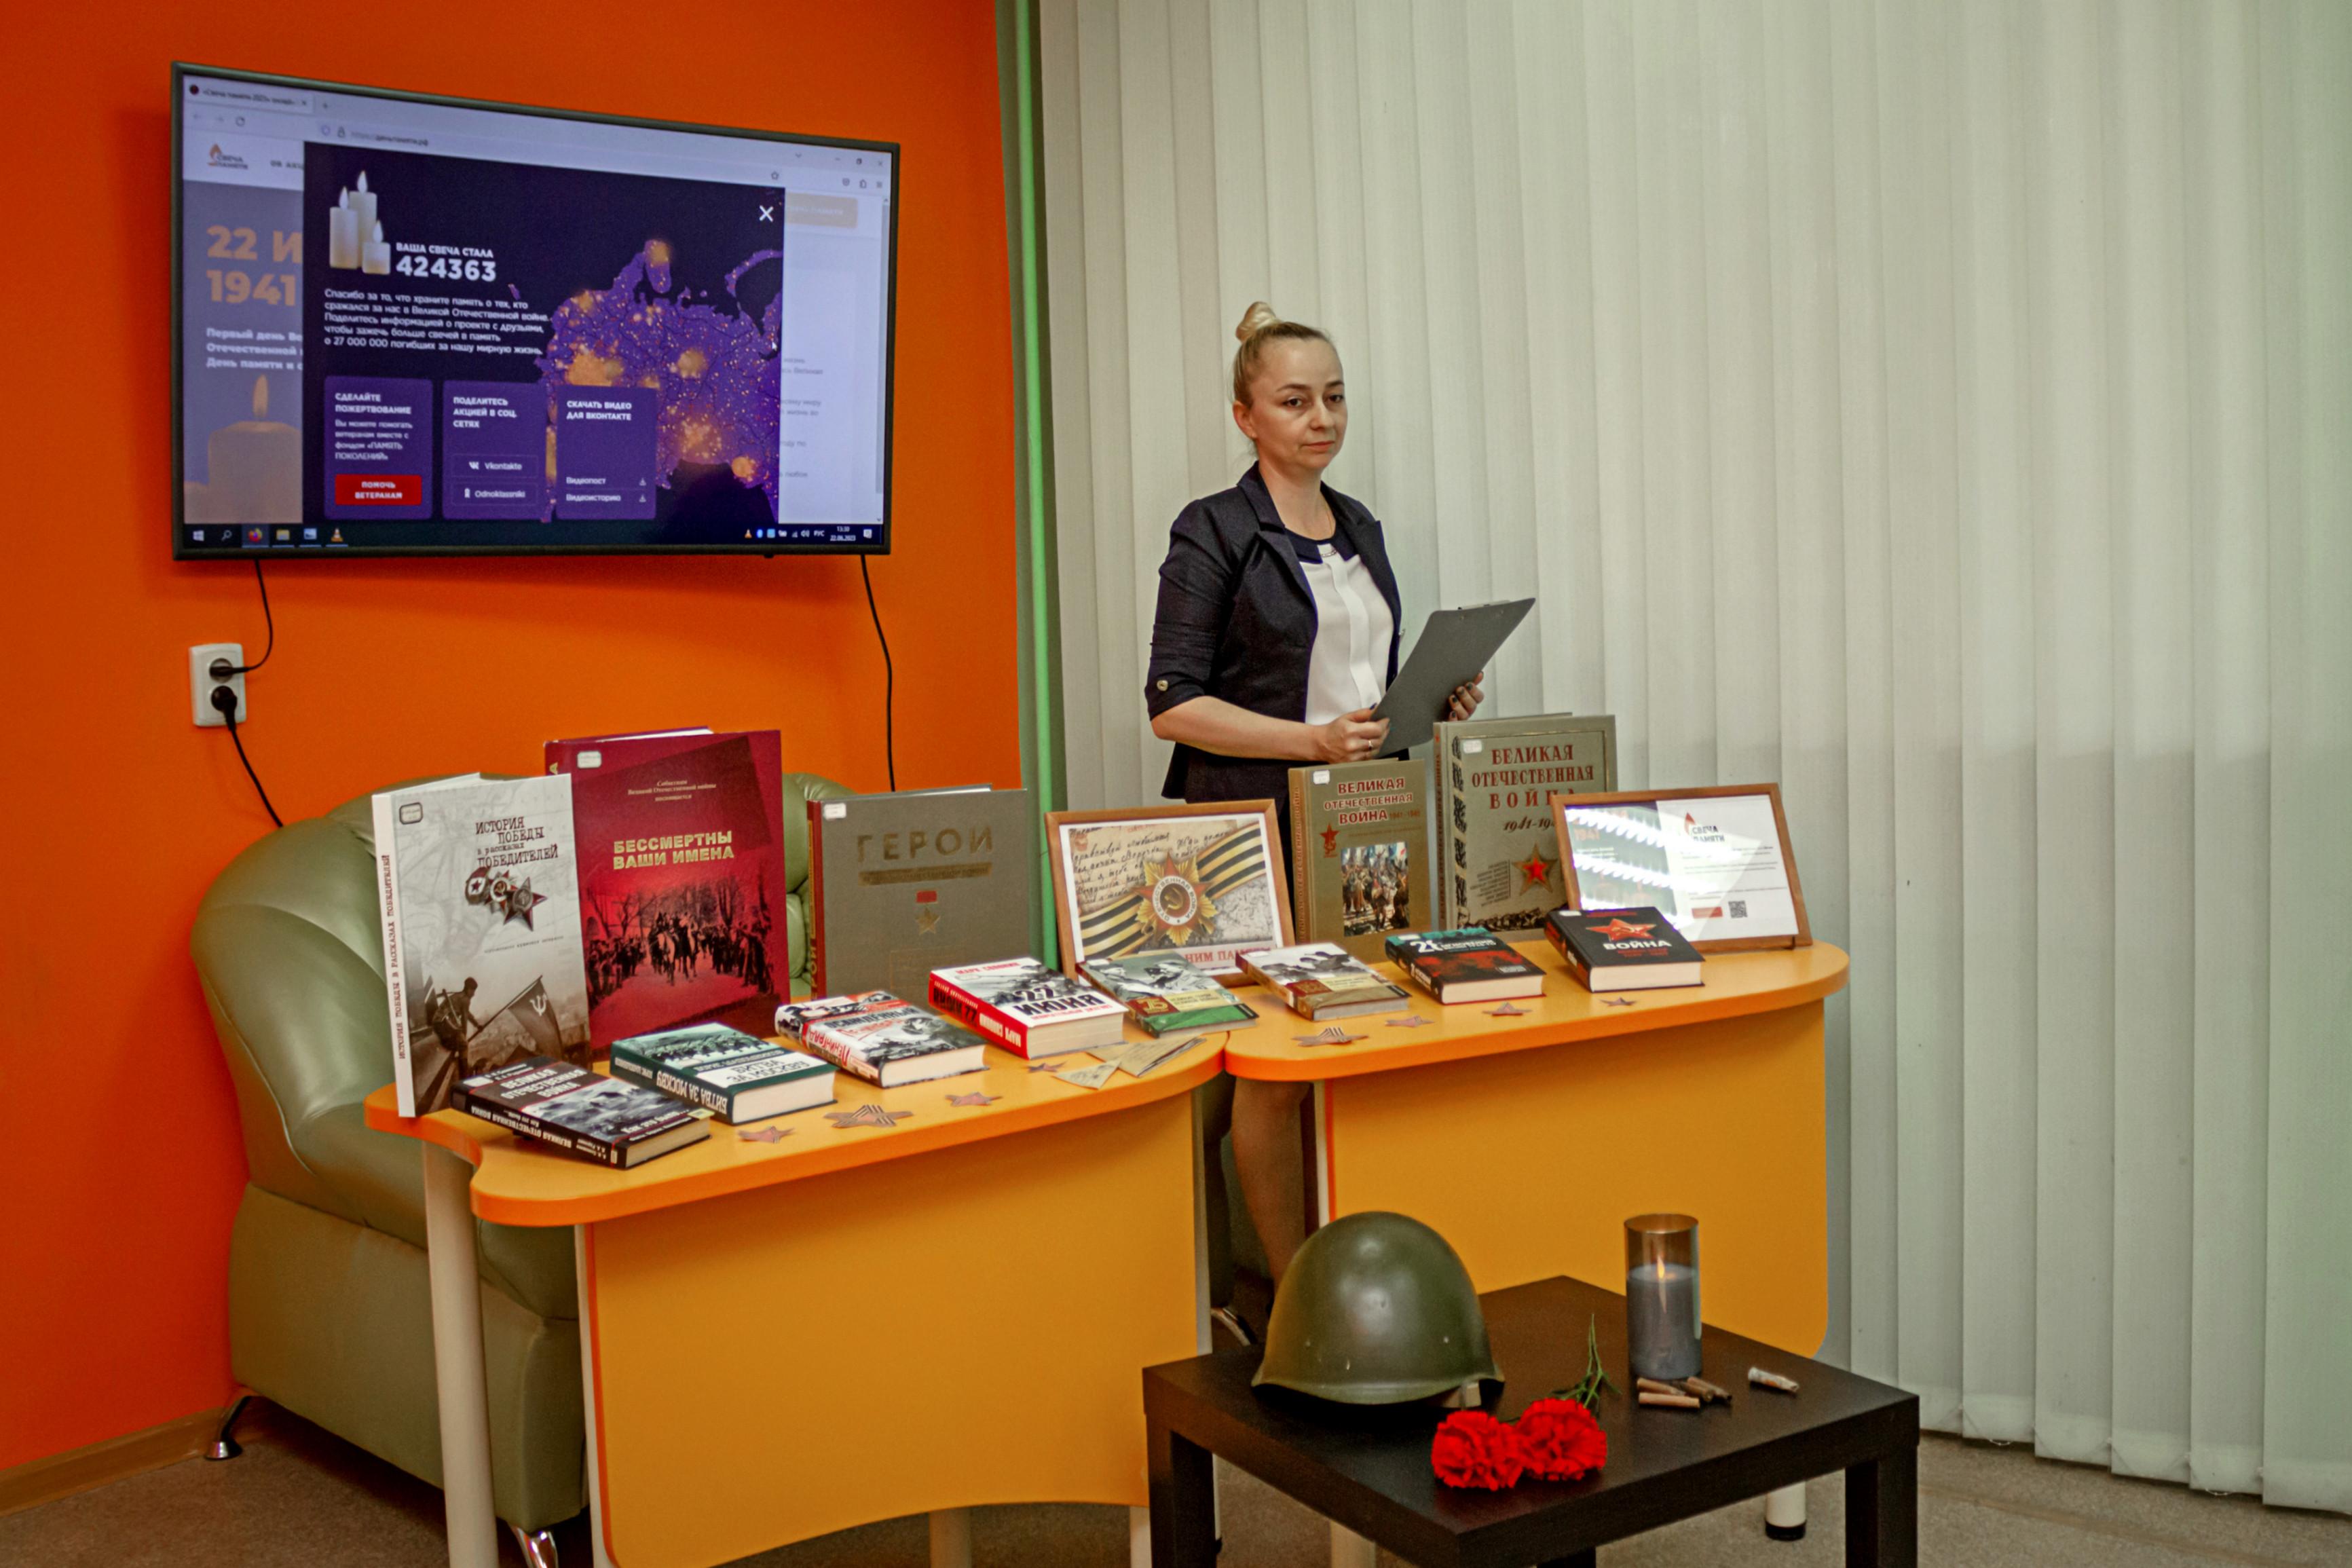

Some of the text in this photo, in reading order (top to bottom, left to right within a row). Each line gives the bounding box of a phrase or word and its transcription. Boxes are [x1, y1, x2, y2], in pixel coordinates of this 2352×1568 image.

[206, 225, 258, 261] 22
[396, 242, 494, 259] ВАША СВЕЧА СТАЛА
[396, 255, 496, 282] 424363
[206, 269, 296, 307] 1941
[324, 288, 365, 300] Спасибо
[367, 293, 377, 301] за
[380, 293, 392, 303] то,
[395, 295, 411, 303] что
[413, 295, 449, 305] храните
[452, 297, 483, 307] память
[494, 300, 511, 310] тех,
[513, 301, 528, 310] кто
[324, 302, 369, 312] сражался
[372, 305, 383, 313] за
[385, 305, 400, 314] нас
[411, 305, 449, 317] Великой
[452, 307, 519, 320] Отечественной
[521, 312, 548, 322] войне.
[324, 313, 544, 335] Поделитесь информацией о проекте с друзьями,
[206, 328, 253, 340] Первый
[256, 331, 285, 341] день
[324, 325, 501, 342] чтобы зажечь больше свечей в память
[206, 343, 297, 356] Отечественной
[324, 337, 331, 346] о
[333, 335, 345, 346] 27
[347, 337, 367, 348] 000
[369, 338, 388, 348] 000
[390, 339, 435, 351] погибших
[438, 343, 449, 352] за
[451, 344, 474, 354] нашу
[477, 344, 511, 356] мирную
[206, 357, 238, 369] День
[240, 359, 282, 370] памяти
[286, 362, 293, 371] и
[335, 392, 381, 403] СДЕЛАЙТЕ
[453, 396, 508, 406] ПОДЕЛИТЕСЬ
[567, 400, 632, 410] СКАЧАТЬ ВИДЕО
[335, 405, 411, 415] ПОЖЕРТВОВАНИЕ
[453, 407, 487, 417] АКЦИЕЙ
[498, 409, 517, 418] СОЦ.
[566, 411, 632, 421] ДЛЯ ВКОНТАКТЕ
[335, 419, 347, 428] Вы
[379, 420, 413, 429] помогать
[453, 420, 479, 428] СЕТЯХ
[335, 431, 375, 440] ветеранам
[377, 431, 403, 439] вместе
[335, 441, 403, 451] фондом «ПАМЯТЬ
[335, 451, 388, 461] ПОКОЛЕНИЙ»
[485, 462, 522, 471] Vkontakte
[362, 481, 396, 489] ПОМОЧЬ
[566, 477, 606, 485] Видеопост
[355, 491, 403, 500] ВЕТЕРАНАМ
[475, 489, 525, 498] Odnoklassniki
[566, 494, 621, 502] Видеоисторию
[1491, 745, 1573, 765] ВЕЛИКАЯ
[1472, 765, 1594, 787] ОТЕЧЕСТВЕННАЯ
[653, 785, 696, 794] Отечественной
[1338, 777, 1405, 796] ВЕЛИКАЯ
[1324, 792, 1413, 811] ОТЕЧЕСТВЕННАЯ
[1489, 787, 1576, 809] ВОЙН
[1339, 807, 1388, 825] ВОЙНА
[475, 816, 525, 836] ИСТОРИЯ
[1692, 825, 1719, 835] СВЕЧА
[498, 827, 545, 844] ПОБЕДЫ
[614, 830, 732, 854] БЕССМЕРТНЫ
[857, 825, 994, 863] ГЕРОИ
[1694, 834, 1725, 842] ПАМЯТИ
[477, 843, 559, 867] ПОБЕДИТЕЛЕЙ
[485, 842, 525, 856] рассказах
[614, 846, 734, 870] ВАШИ ИМЕНА
[381, 855, 393, 917] ПОБЕДИТЕЛЕЙ
[387, 921, 398, 968] РАССКАЗАХ
[1603, 939, 1672, 950] ВОЙНА
[1013, 986, 1059, 1003] 22
[1013, 994, 1106, 1017] ИЮНЯ
[1005, 1026, 1022, 1048] МАРК
[726, 1061, 810, 1083] ЗА МОСКВУ
[732, 1059, 785, 1074] БИТВА
[500, 1068, 557, 1089] ВЕЛИКАЯ
[500, 1069, 588, 1099] ОТЕЧЕСТВЕННАЯ
[537, 1081, 582, 1098] ВОЙНА
[656, 1070, 728, 1115] БИТВА ЗА МОСКВУ
[471, 1105, 572, 1149] ВЕЛИКАЯ ОТЕЧЕСТВЕННАЯ ВОЙНА
